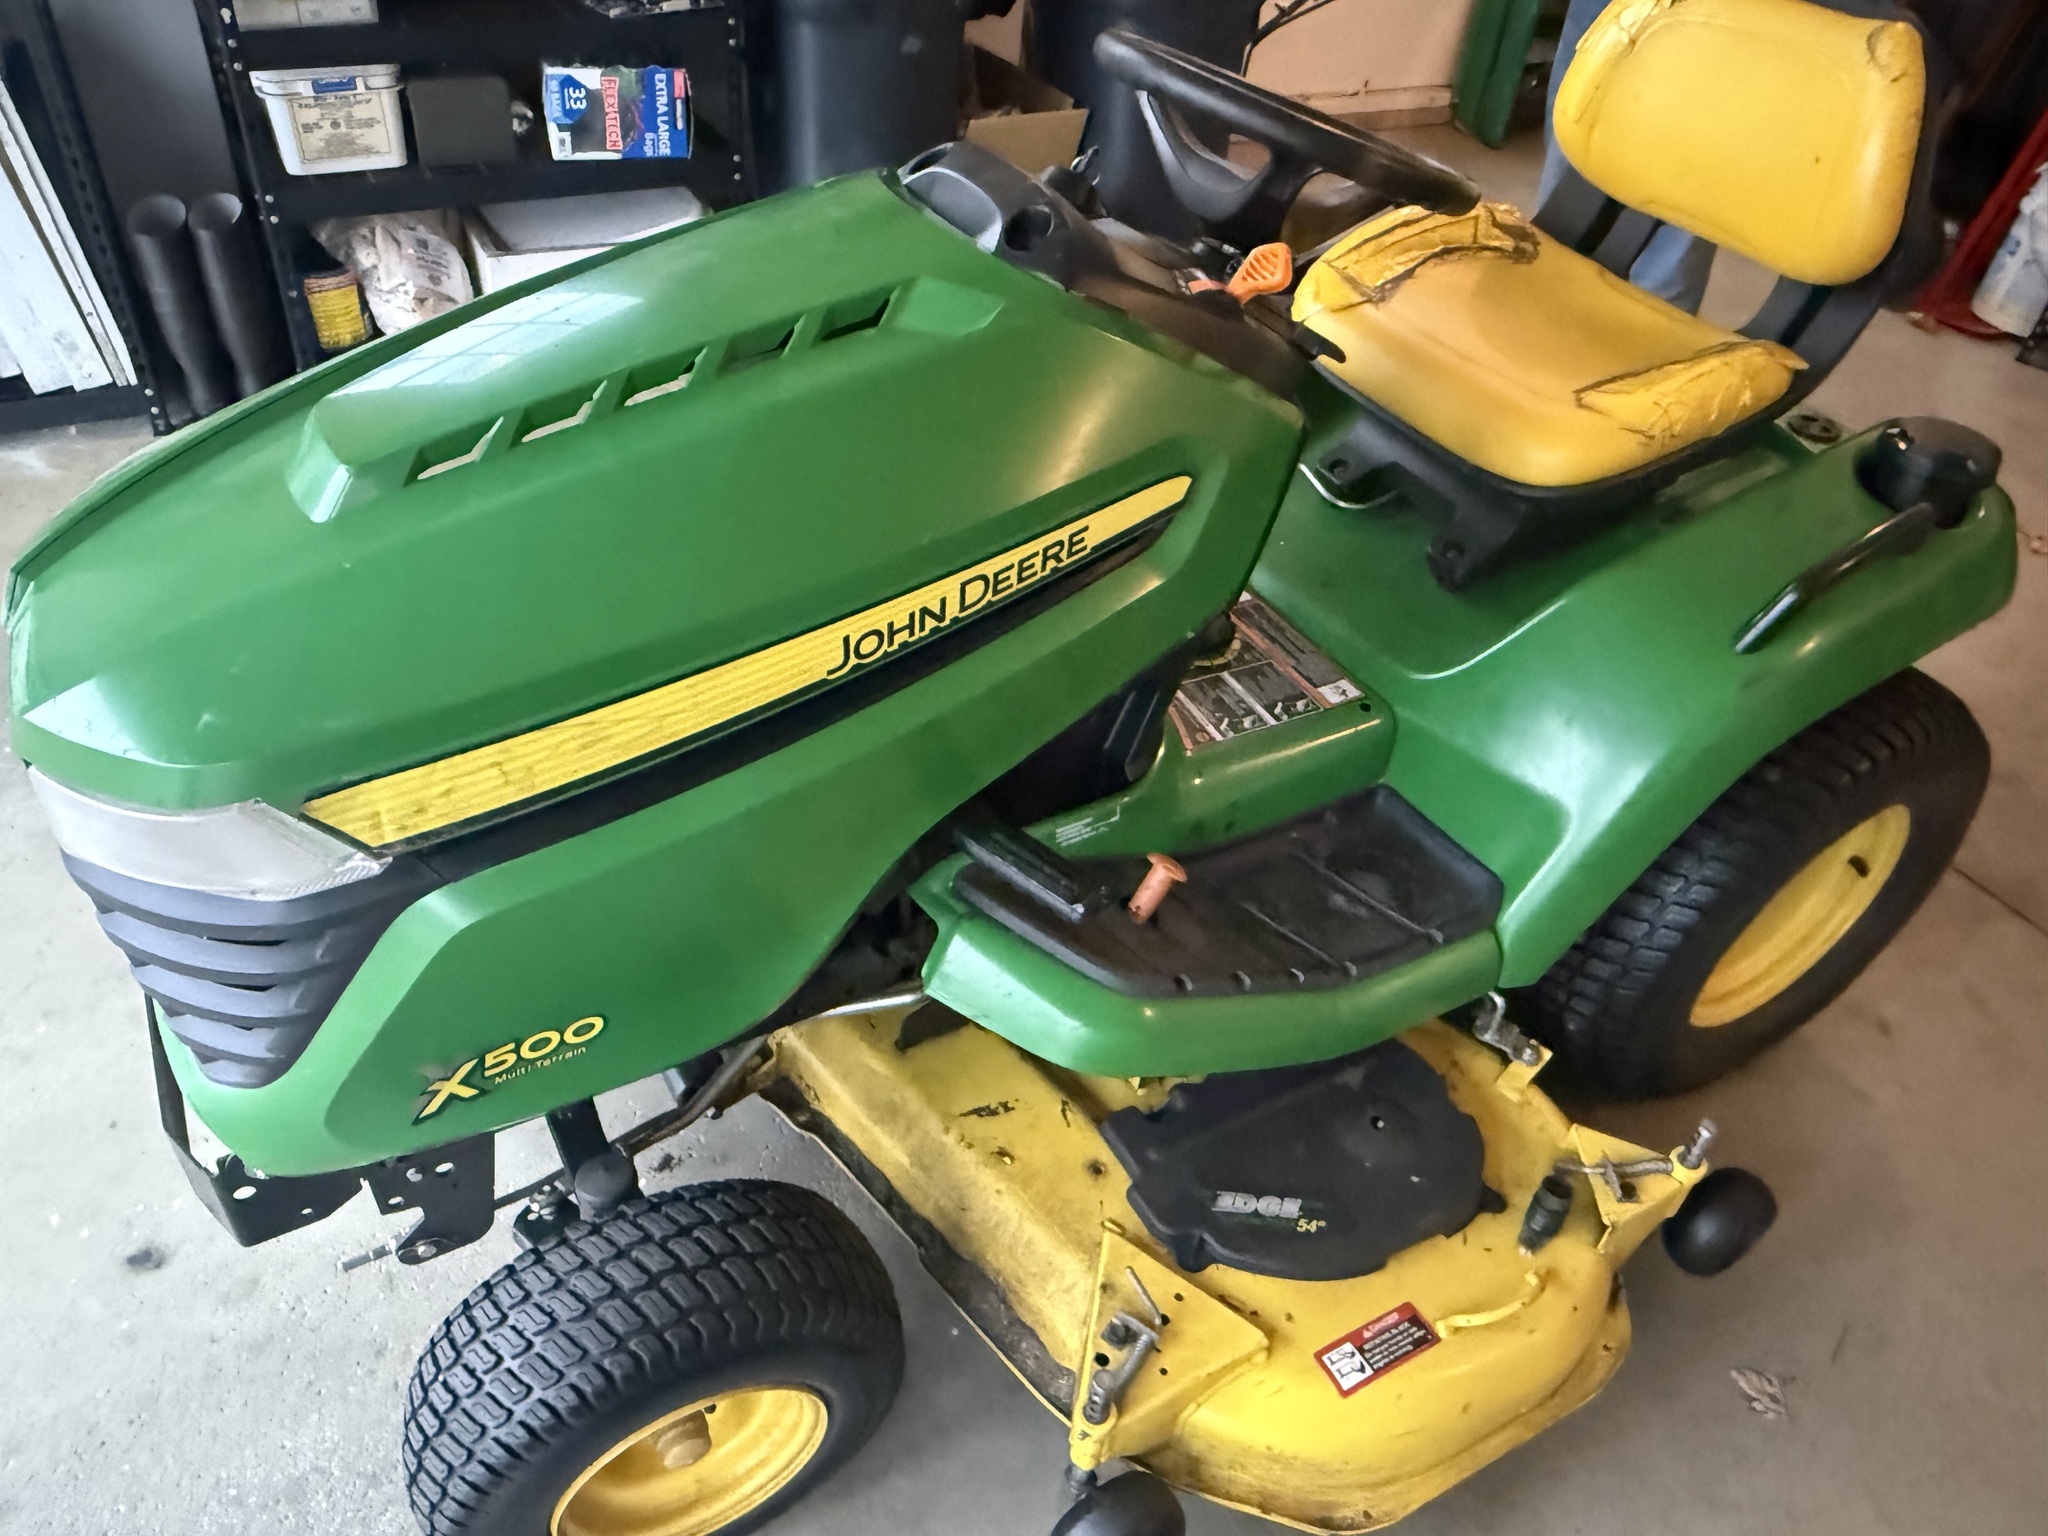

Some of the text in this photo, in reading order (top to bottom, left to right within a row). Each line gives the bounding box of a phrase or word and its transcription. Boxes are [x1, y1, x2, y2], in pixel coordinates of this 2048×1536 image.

[568, 87, 587, 110] 33
[654, 73, 672, 157] EXTRA LARGE
[826, 525, 1090, 677] JOHN DEERE
[416, 1016, 605, 1120] X500
[535, 1046, 587, 1069] Terrain
